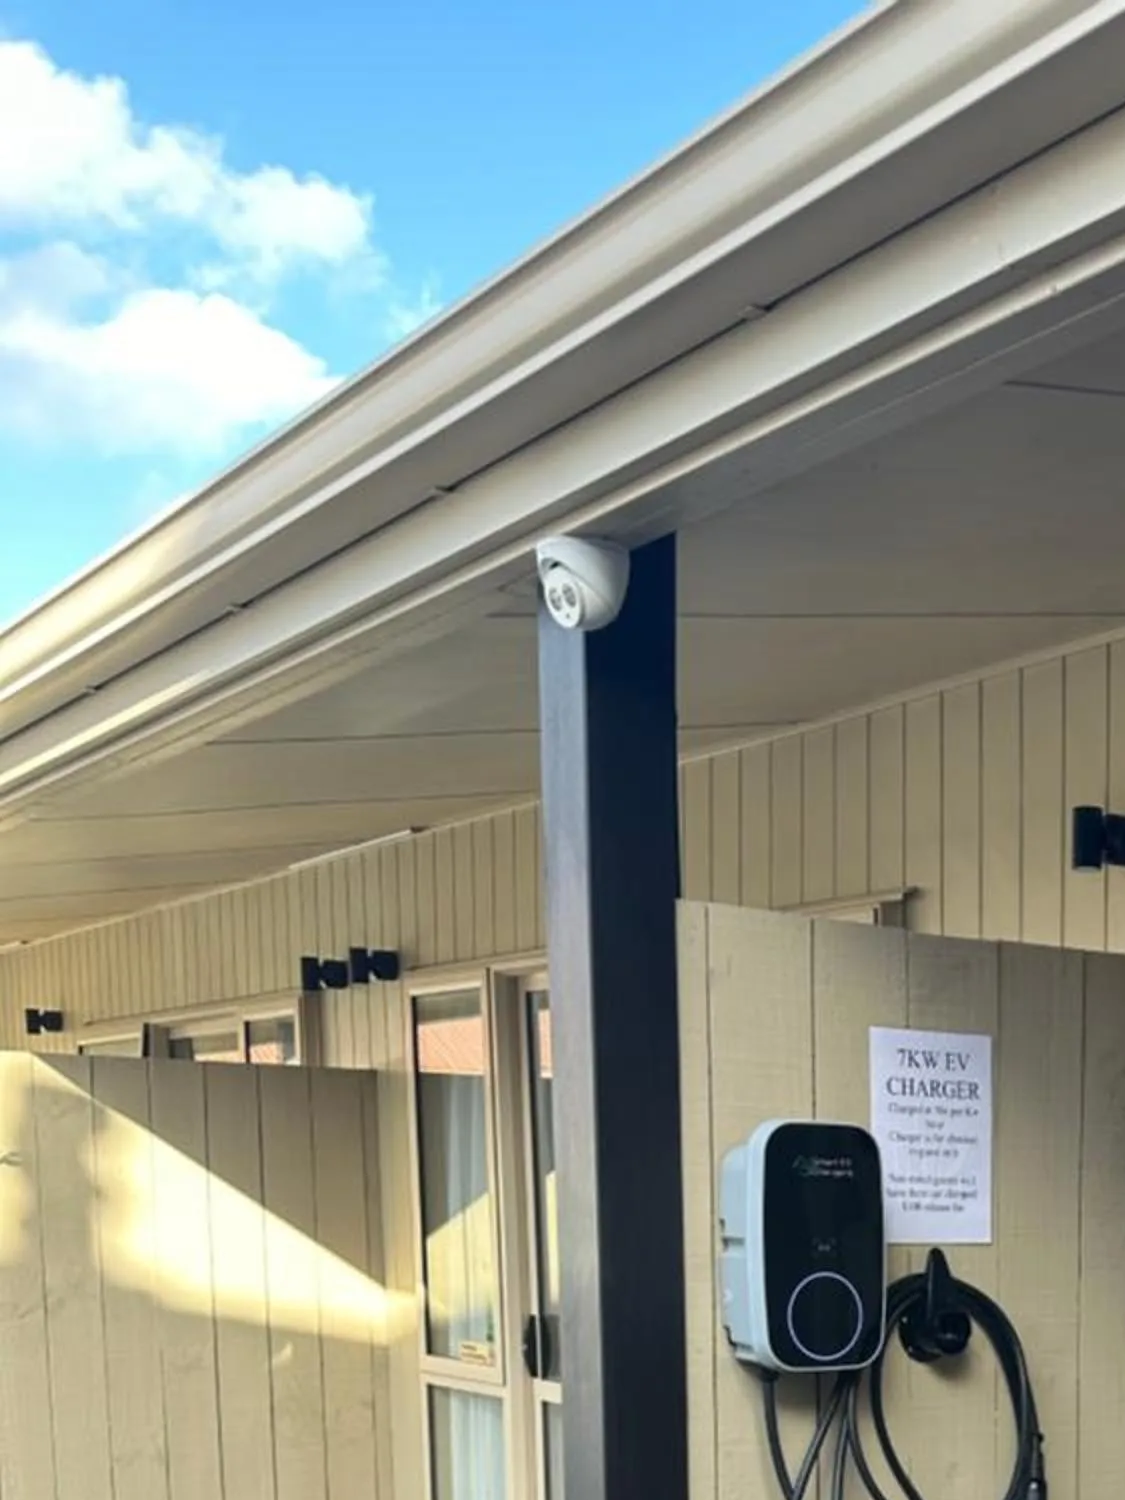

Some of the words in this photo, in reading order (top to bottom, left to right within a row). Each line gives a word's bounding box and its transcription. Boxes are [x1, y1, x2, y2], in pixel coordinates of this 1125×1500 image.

[897, 1048, 940, 1070] 7KW
[945, 1051, 971, 1072] EV
[886, 1076, 980, 1101] CHARGER
